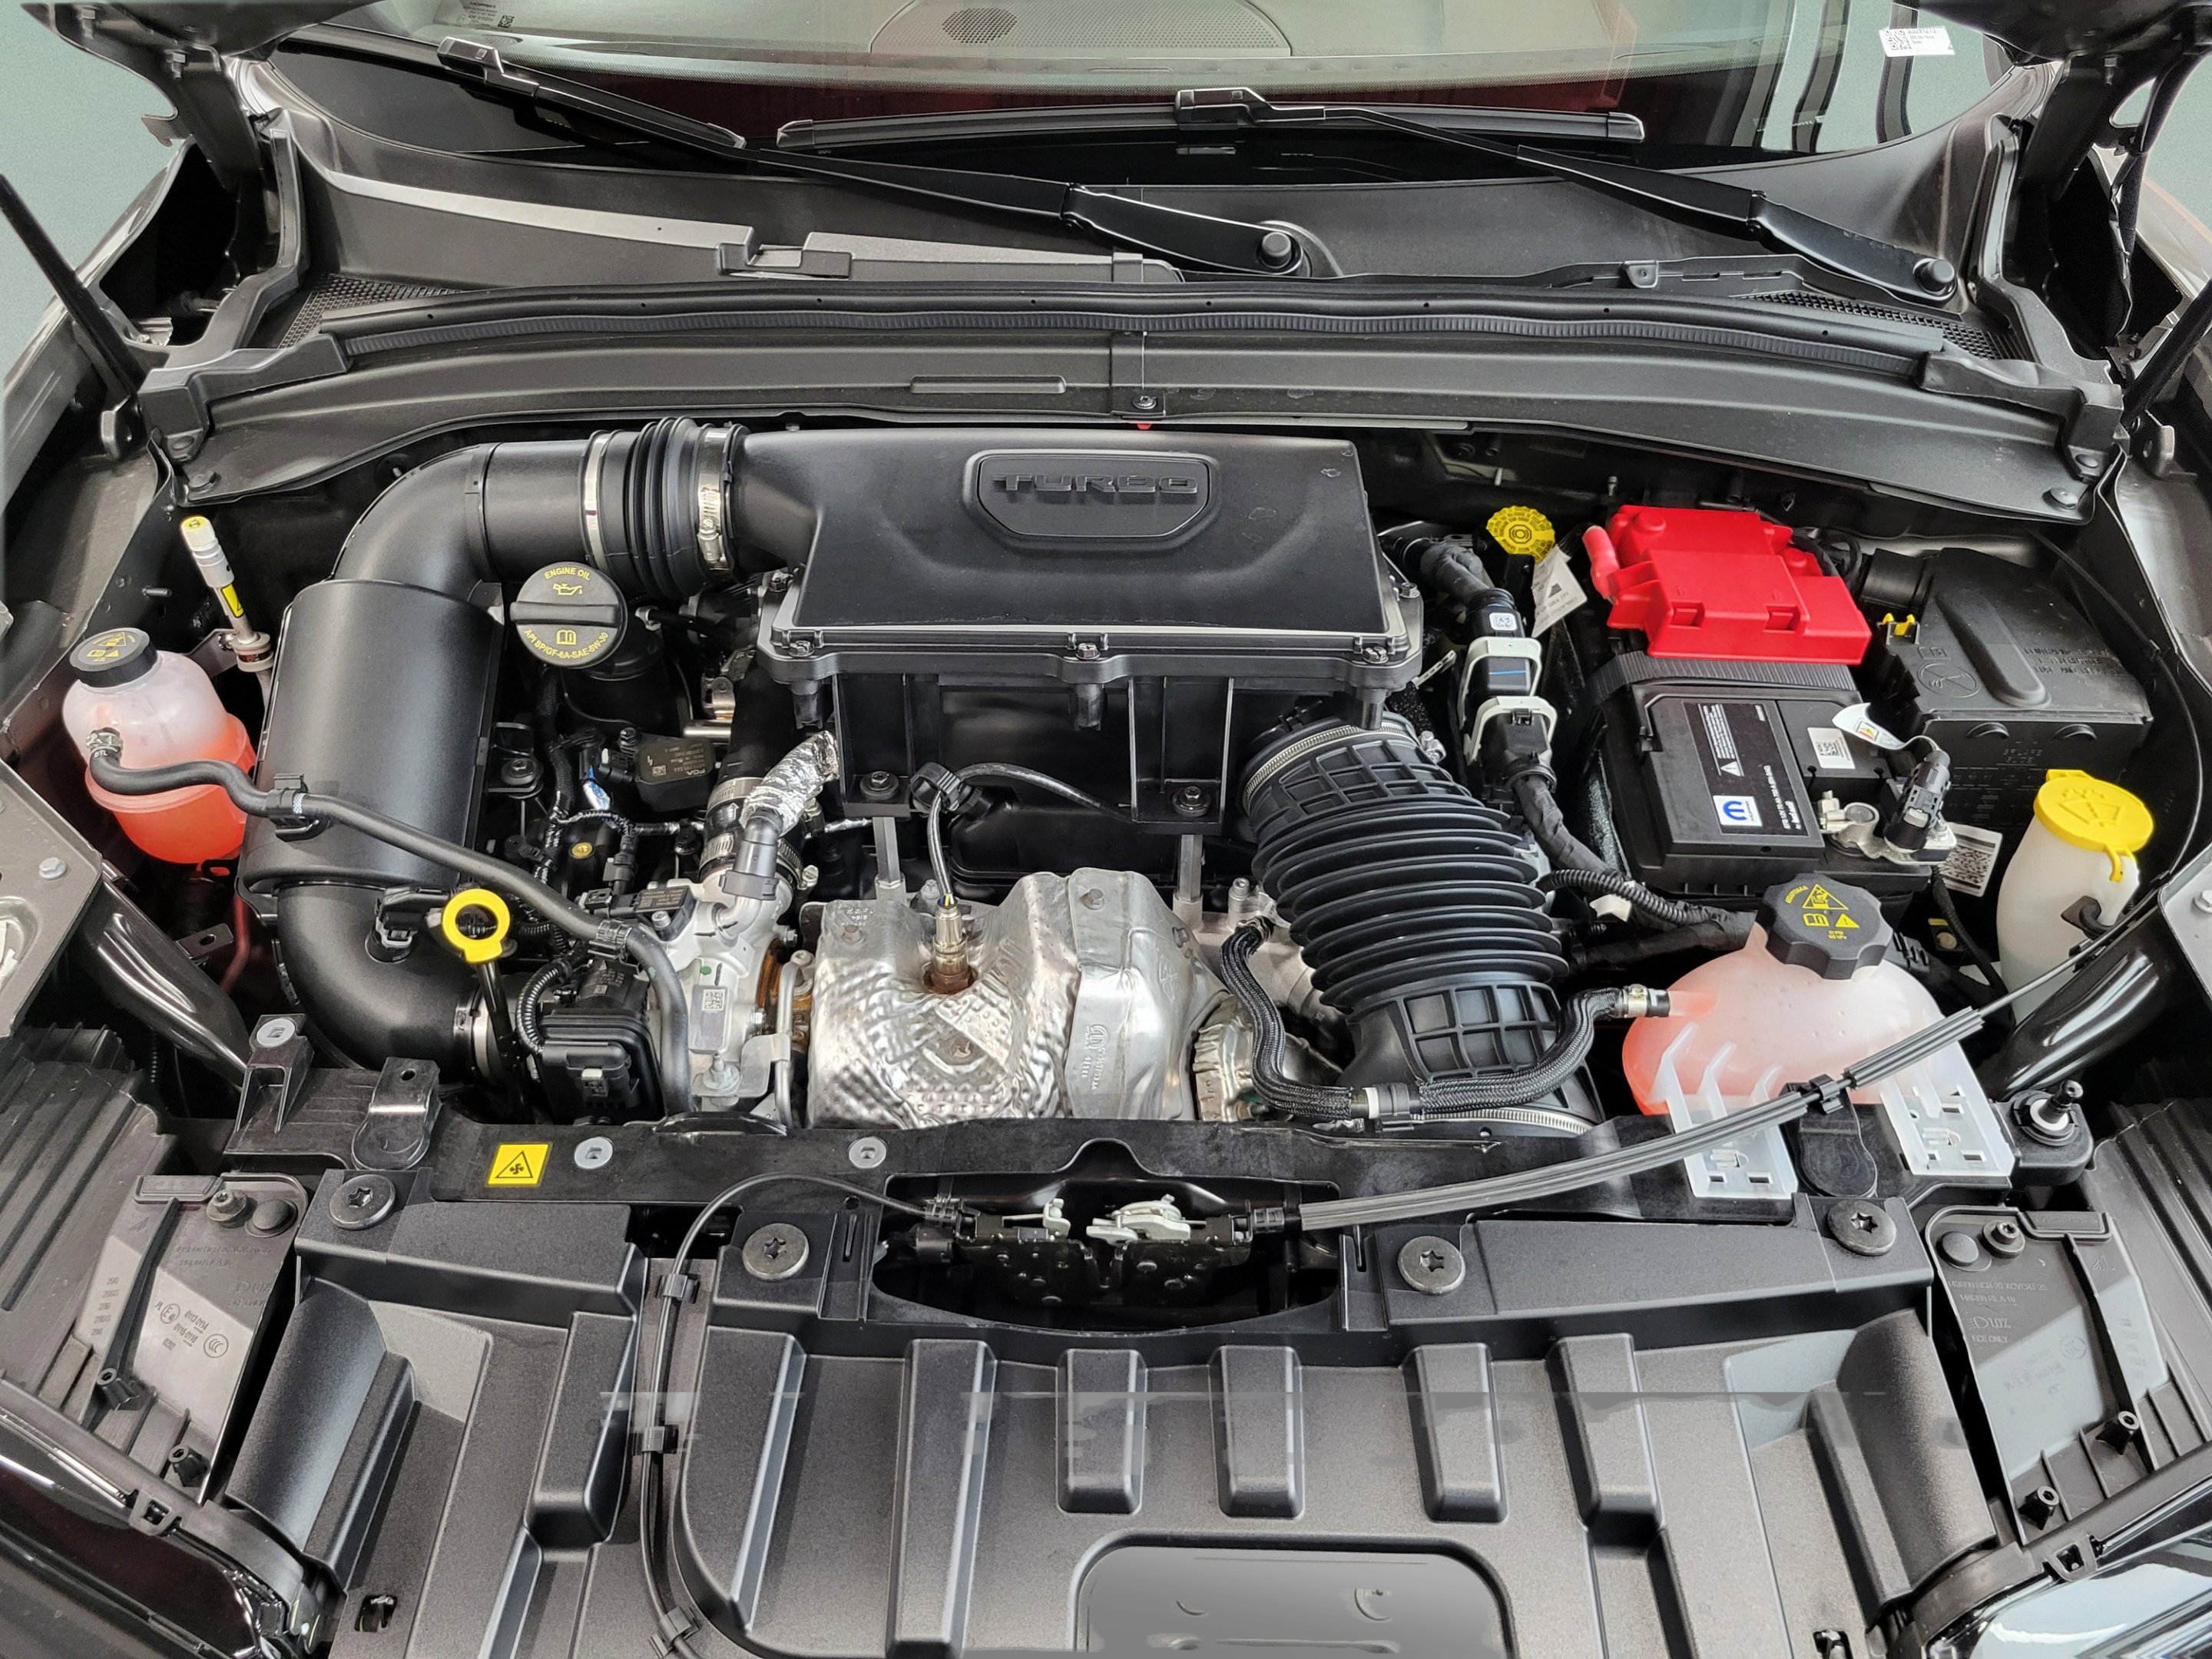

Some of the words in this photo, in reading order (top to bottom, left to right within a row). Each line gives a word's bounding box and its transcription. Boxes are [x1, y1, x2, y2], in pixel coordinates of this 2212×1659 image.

[993, 473, 1198, 494] TURBO
[544, 567, 577, 579] ENGINE
[578, 569, 591, 581] OIL
[525, 628, 537, 643] API
